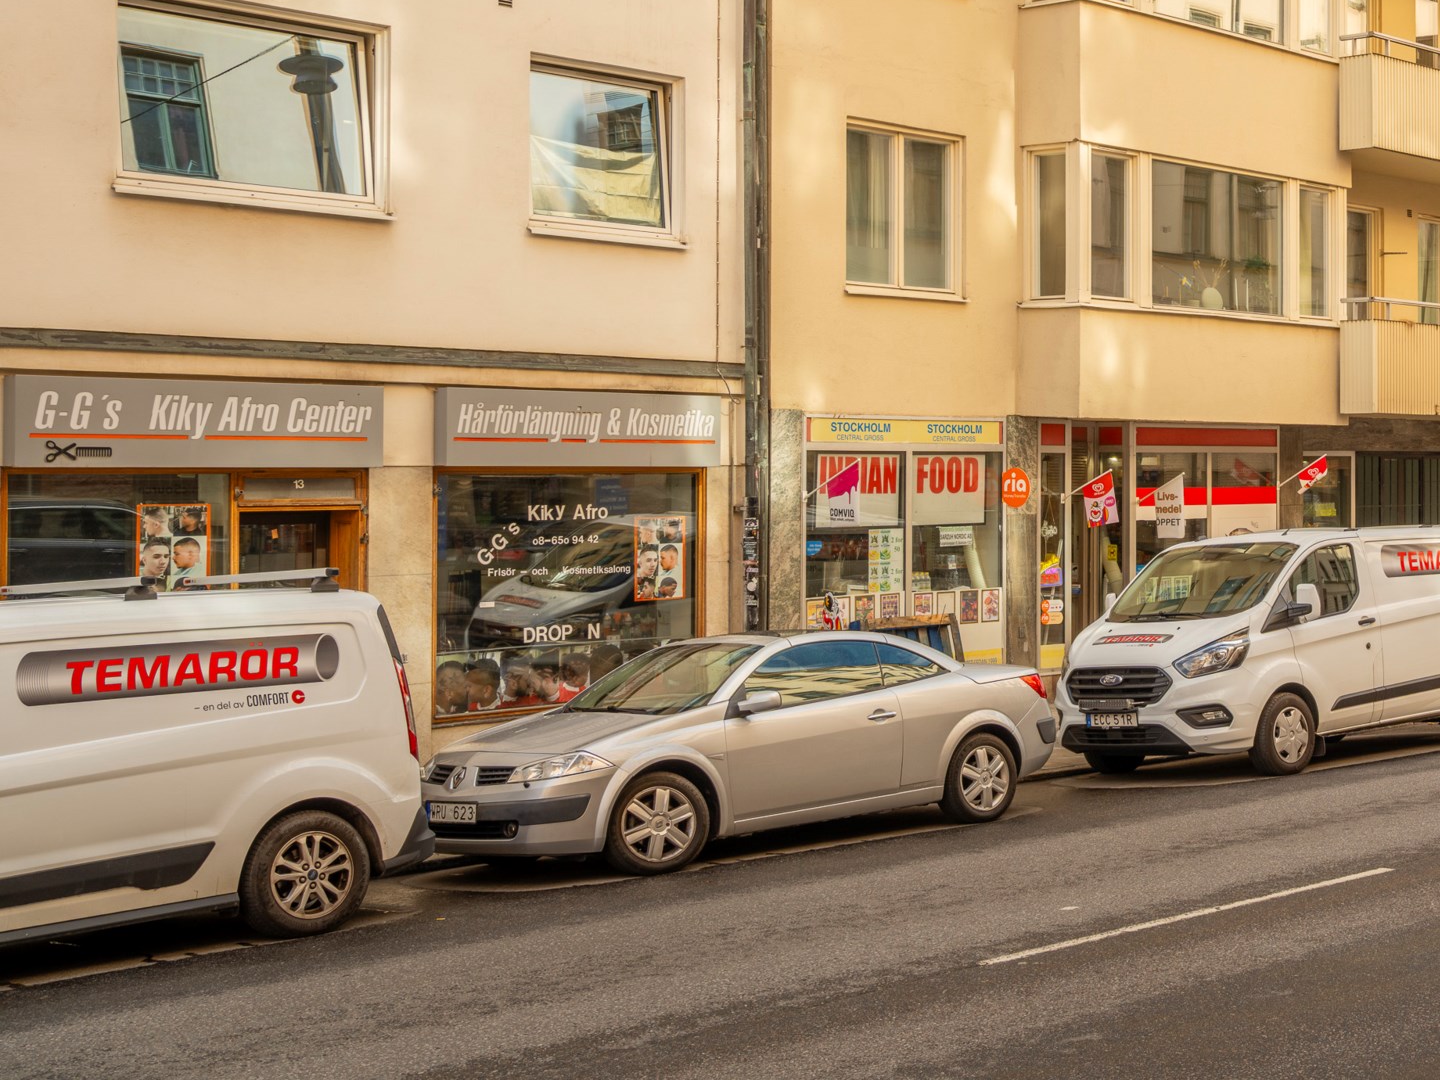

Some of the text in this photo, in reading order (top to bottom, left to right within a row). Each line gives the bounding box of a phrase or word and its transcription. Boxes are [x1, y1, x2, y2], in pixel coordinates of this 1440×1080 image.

[149, 394, 213, 440] Kiky
[217, 396, 280, 433] Afro
[286, 397, 372, 434] Center
[456, 402, 715, 444] Hårförlängning & Kosmetika
[830, 421, 891, 433] STOCKHOLM
[927, 423, 983, 434] STOCKHOLM
[836, 433, 863, 441] CENTRAL
[916, 456, 979, 494] FOOD
[1004, 472, 1027, 492] ria
[293, 479, 305, 490] 13
[1157, 491, 1179, 501] Livs-
[527, 504, 609, 522] Kiky Afro
[830, 508, 855, 518] COMVIQ
[571, 535, 584, 545] 94
[587, 534, 599, 544] 42
[487, 566, 517, 577] Frisör
[532, 567, 549, 576] och
[562, 565, 631, 576] Kosmetiksalong
[523, 624, 573, 644] DROP
[66, 642, 300, 695] TEMARÖR
[202, 702, 215, 712] en
[216, 700, 231, 711] del
[233, 701, 245, 709] av
[246, 691, 290, 707] COMFORT
[1093, 714, 1133, 726] ECC 51R
[430, 803, 474, 821] WRU 623
